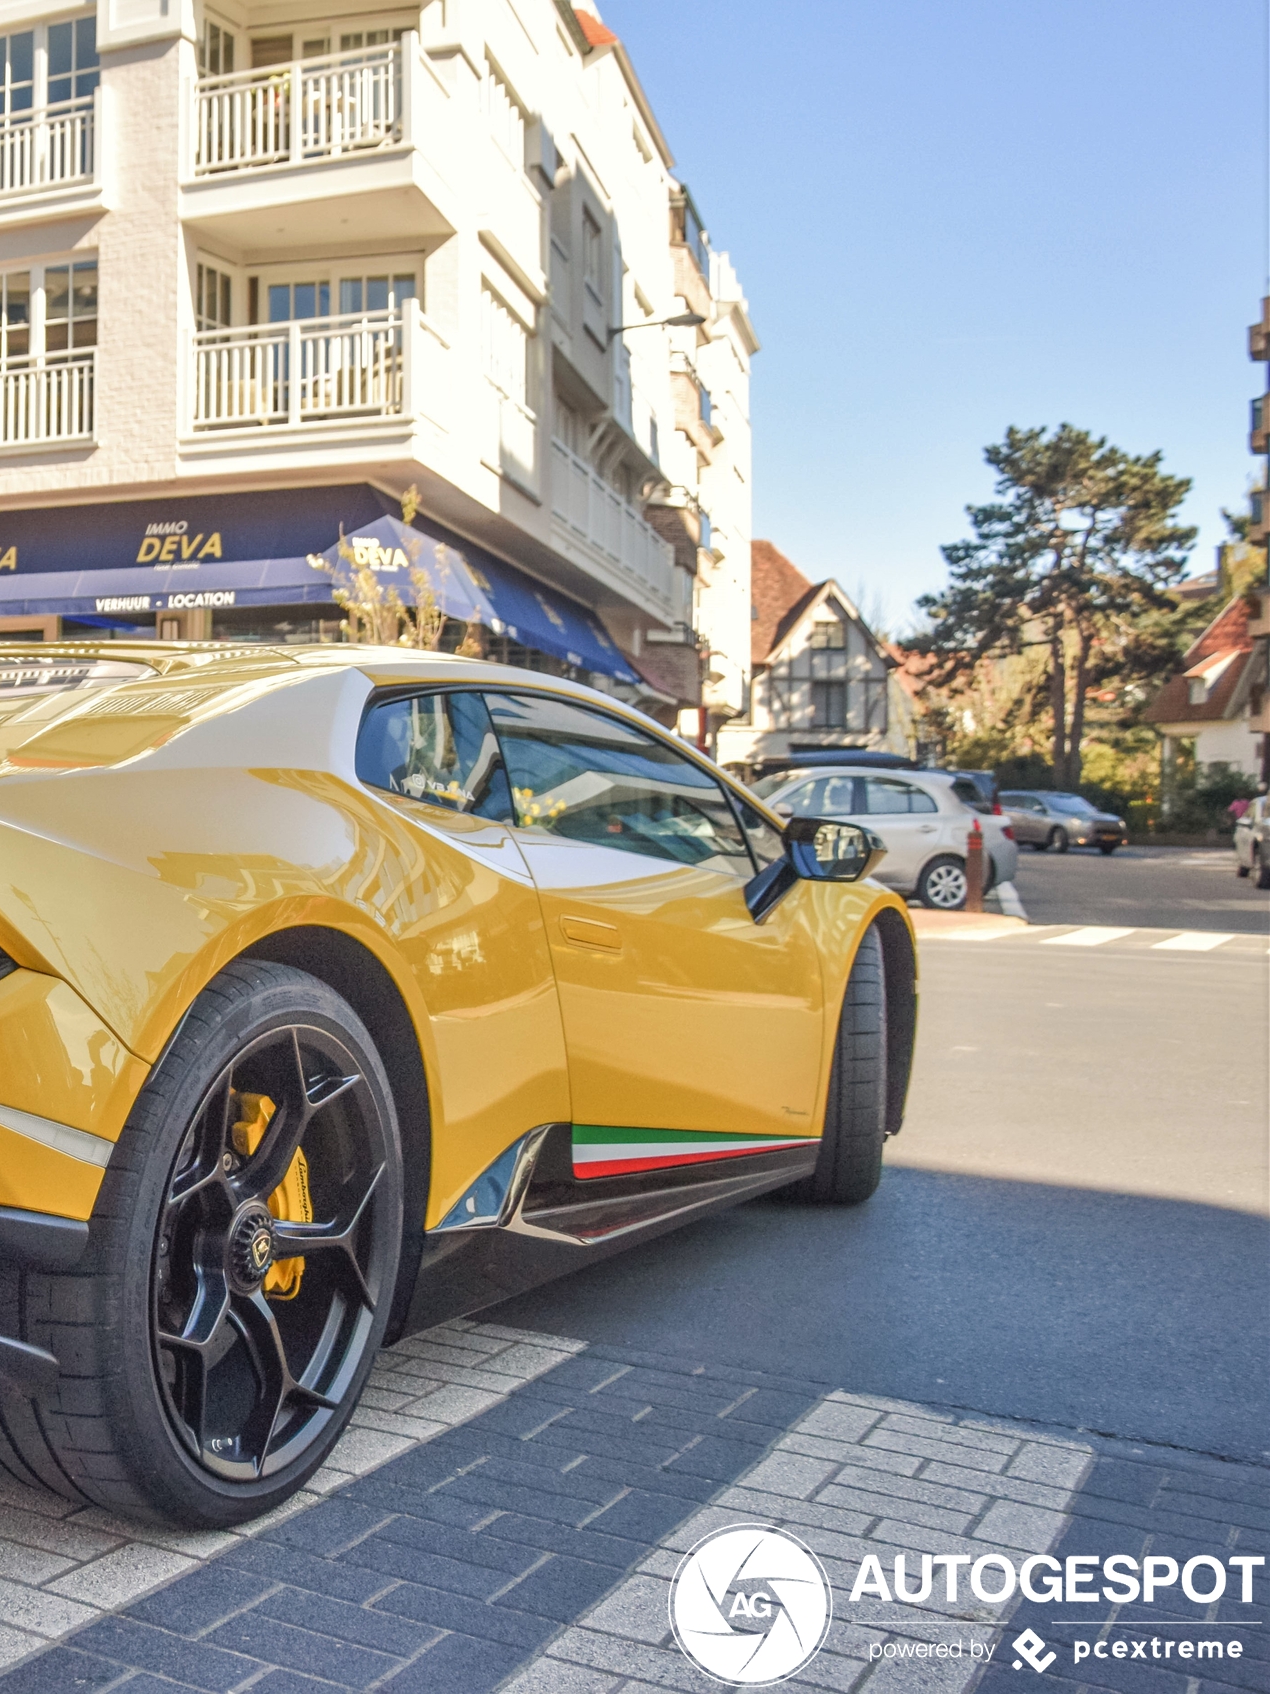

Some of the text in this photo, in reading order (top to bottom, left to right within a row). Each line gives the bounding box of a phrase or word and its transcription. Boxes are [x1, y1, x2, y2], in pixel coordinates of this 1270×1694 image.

[145, 521, 188, 535] IMMO
[136, 532, 223, 563] DEVA
[354, 546, 409, 567] DEVA
[96, 592, 235, 612] VERHUUR LOCATION
